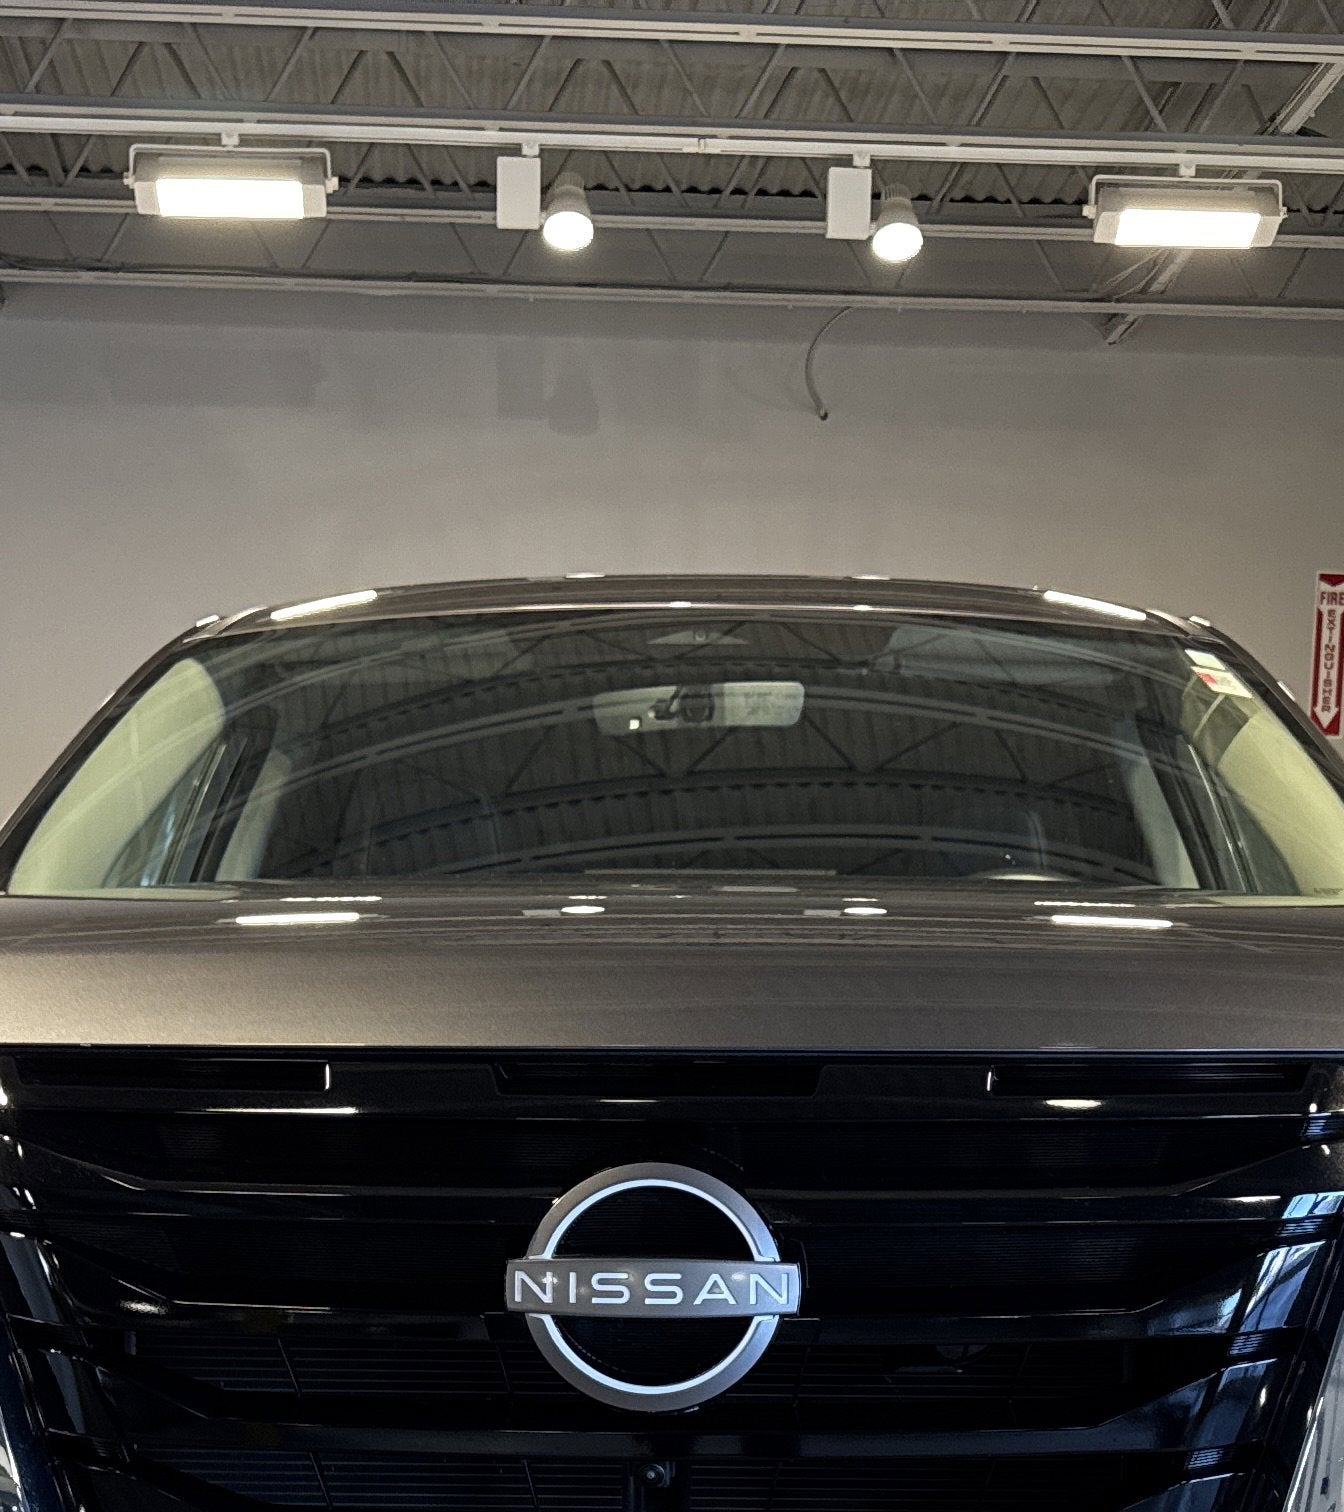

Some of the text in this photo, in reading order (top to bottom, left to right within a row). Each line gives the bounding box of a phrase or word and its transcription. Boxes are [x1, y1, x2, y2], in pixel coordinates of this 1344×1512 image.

[1320, 592, 1344, 606] FIRE
[1321, 609, 1336, 713] EXTINGUISHER
[513, 1270, 790, 1306] NISSAN
